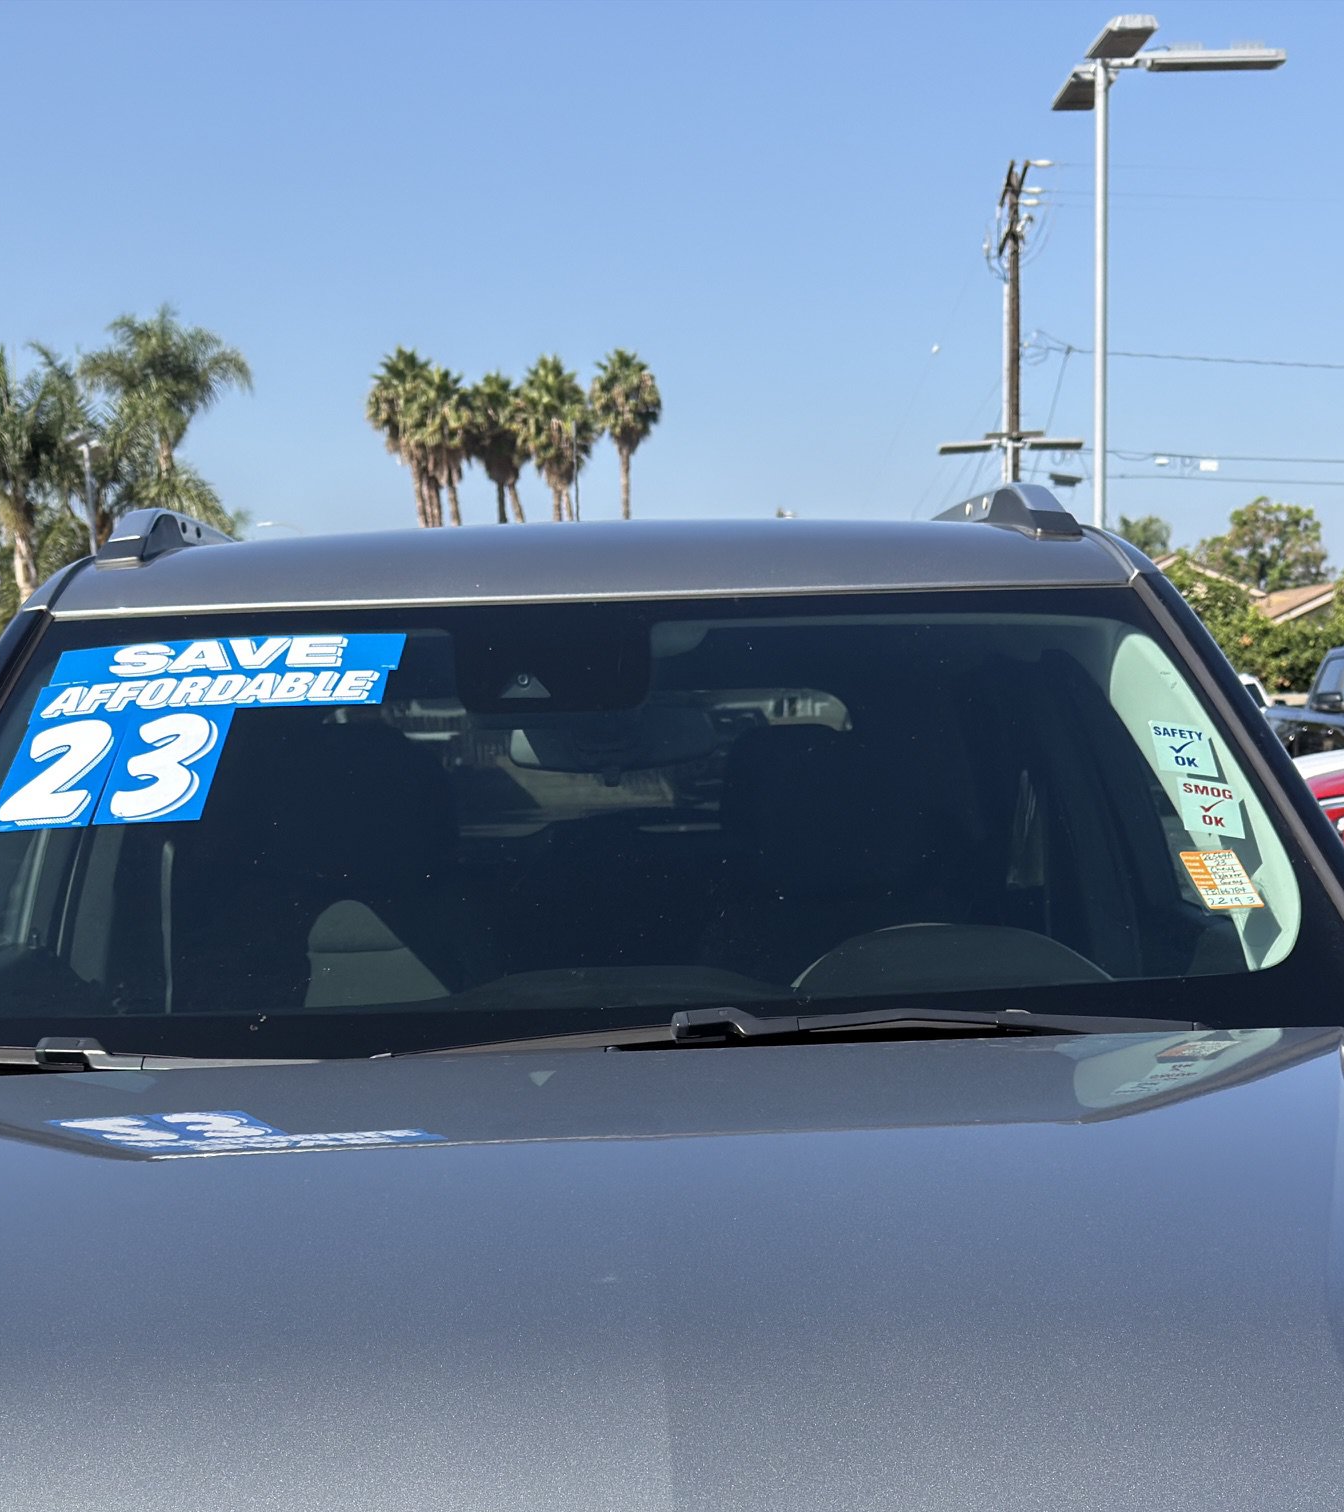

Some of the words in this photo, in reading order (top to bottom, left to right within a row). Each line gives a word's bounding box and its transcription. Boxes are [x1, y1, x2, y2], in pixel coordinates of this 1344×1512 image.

[109, 635, 348, 677] SAVE
[40, 669, 379, 718] AFFORDABLE
[1153, 726, 1203, 741] SAFETY
[1174, 755, 1199, 768] OK
[1183, 783, 1233, 800] SMOG
[1202, 814, 1226, 828] OK
